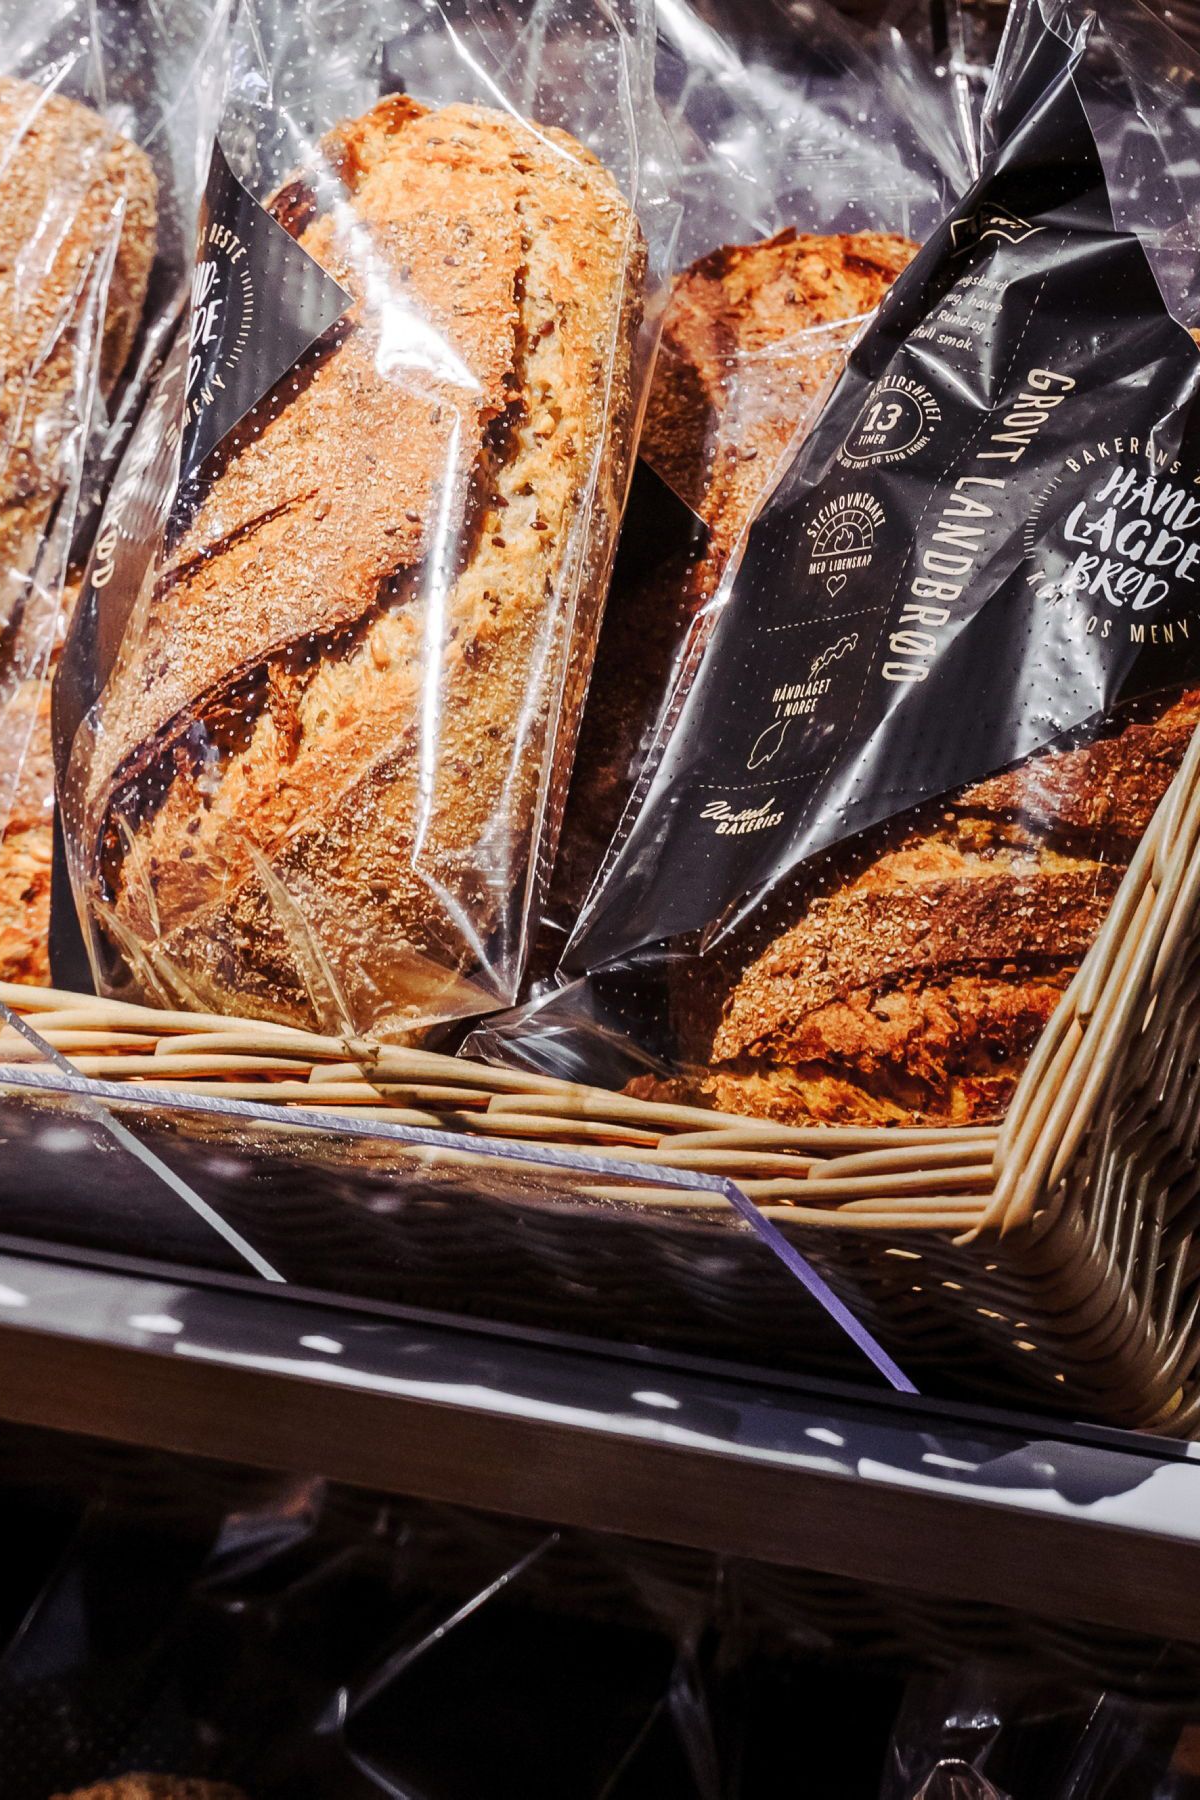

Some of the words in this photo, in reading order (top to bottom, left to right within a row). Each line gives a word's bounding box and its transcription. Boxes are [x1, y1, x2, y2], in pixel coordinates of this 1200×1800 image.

[967, 295, 1003, 313] havre
[937, 309, 972, 326] Rund
[972, 322, 986, 335] og
[937, 334, 973, 352] smak.
[862, 401, 903, 432] 13
[976, 368, 1076, 463] GROVT
[858, 433, 887, 446] TIMER
[871, 456, 881, 465] OG
[886, 453, 906, 463] SPRØ
[906, 435, 931, 456] SKORPE
[1065, 437, 1182, 474] BAKERENS
[806, 491, 886, 539] STEINOVNSBAKT
[1064, 501, 1200, 583] LAGDE
[808, 560, 827, 575] MED
[829, 554, 873, 572] LIDENSKAP
[881, 476, 1005, 683] LANDBRØD
[1069, 551, 1169, 611] BRØD
[1130, 618, 1190, 644] MENY
[772, 678, 832, 702] HÅNDLAGET
[774, 704, 782, 718] I
[783, 698, 819, 717] NORGE
[700, 798, 775, 822] United
[715, 812, 785, 835] BAKERIES
